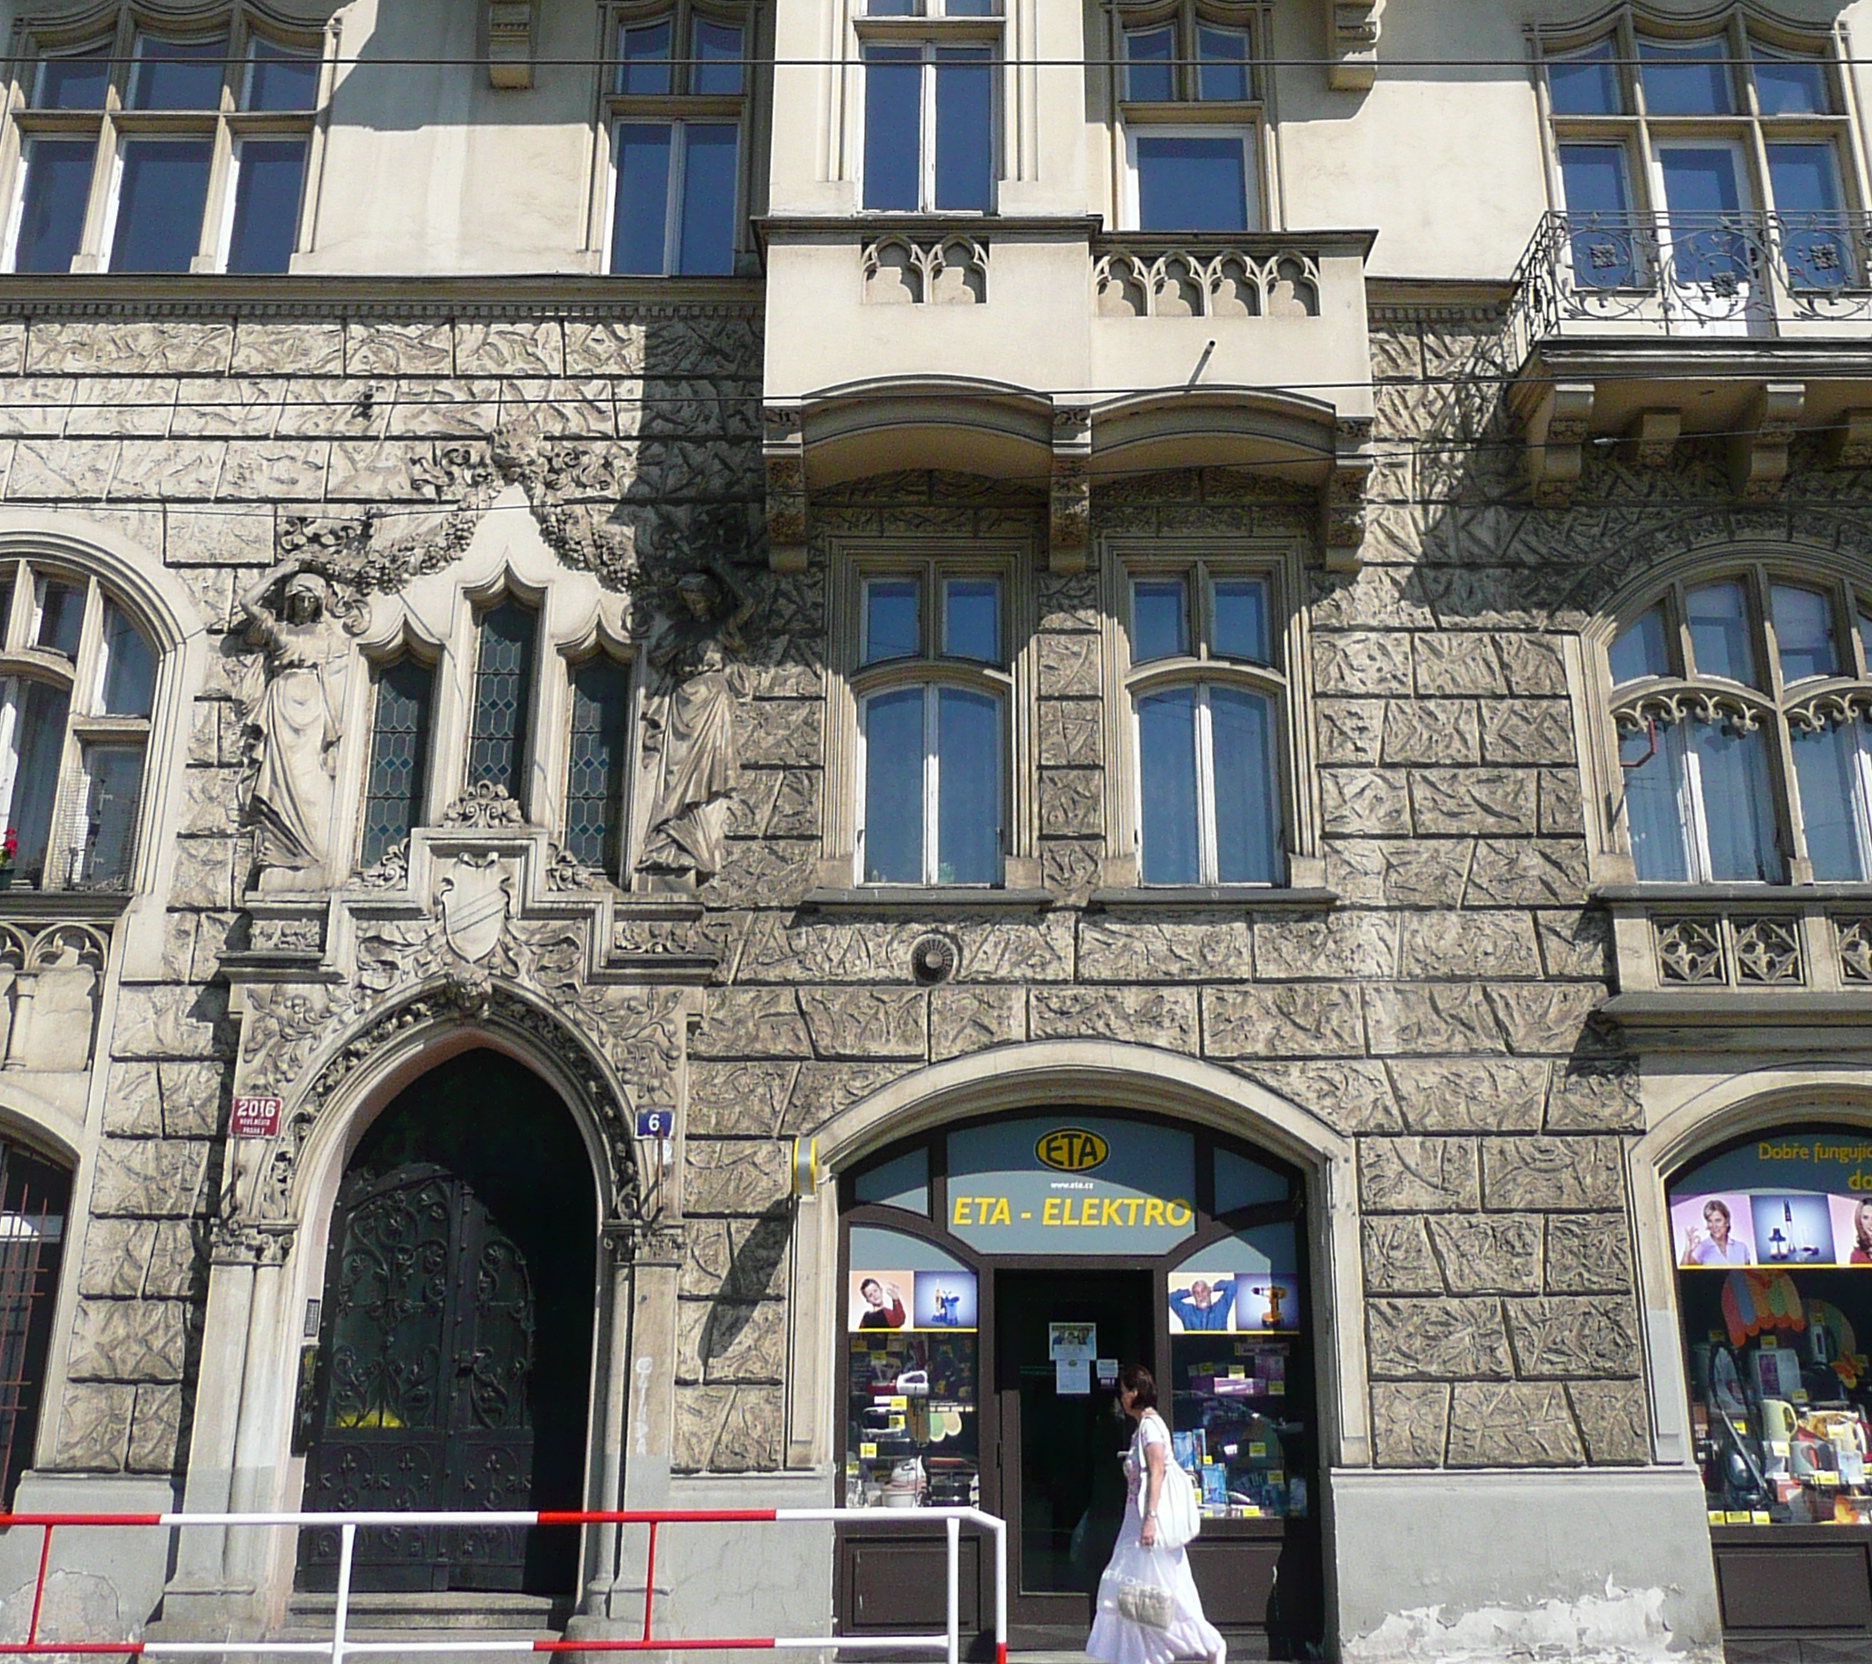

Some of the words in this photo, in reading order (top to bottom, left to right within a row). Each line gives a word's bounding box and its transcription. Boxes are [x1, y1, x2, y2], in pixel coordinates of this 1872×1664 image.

[237, 1100, 276, 1117] 2016
[648, 1114, 660, 1131] 6
[1046, 1133, 1098, 1167] ETA
[1758, 1143, 1809, 1160] Dobře
[953, 1197, 1011, 1225] ETA
[1021, 1211, 1031, 1219] -
[1042, 1198, 1191, 1226] ELEKTRO
